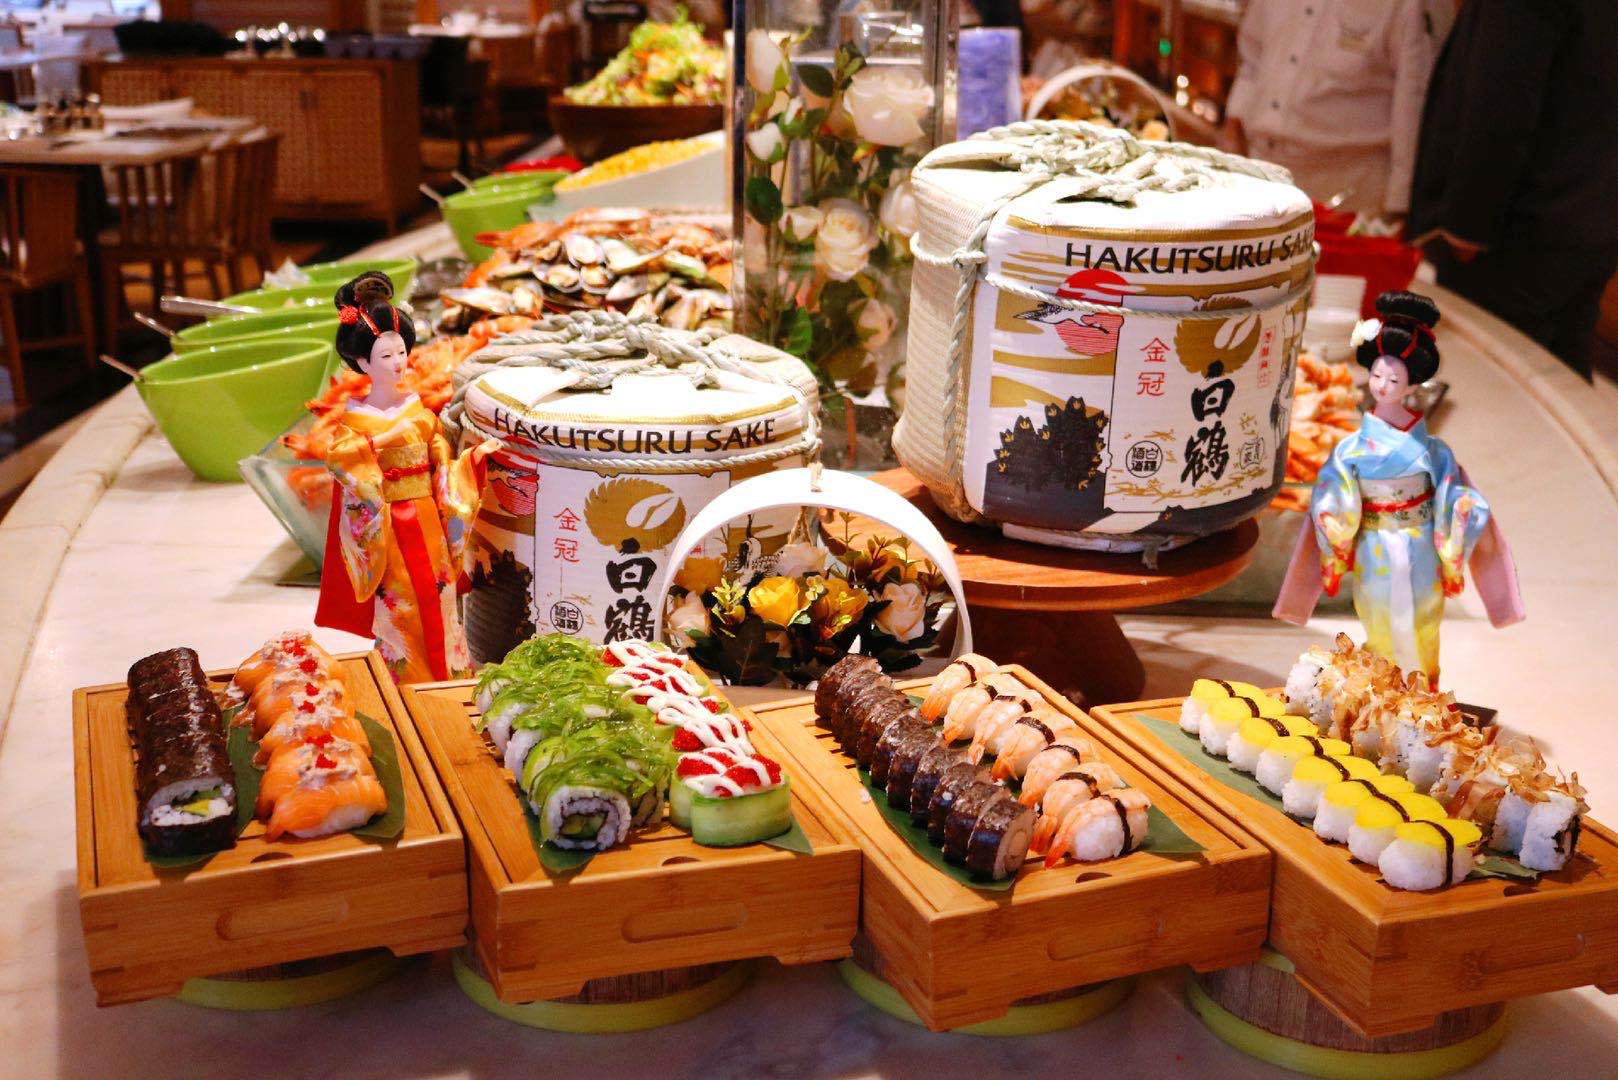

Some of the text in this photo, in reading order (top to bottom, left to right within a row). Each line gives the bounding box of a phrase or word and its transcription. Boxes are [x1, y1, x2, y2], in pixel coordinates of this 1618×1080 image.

[1065, 239, 1275, 274] HAKUTSURU
[1137, 337, 1171, 397] 金冠
[494, 408, 776, 455] HAKUTSURU SAKE
[1180, 360, 1236, 487] 白鶴
[553, 507, 581, 563] 金冠
